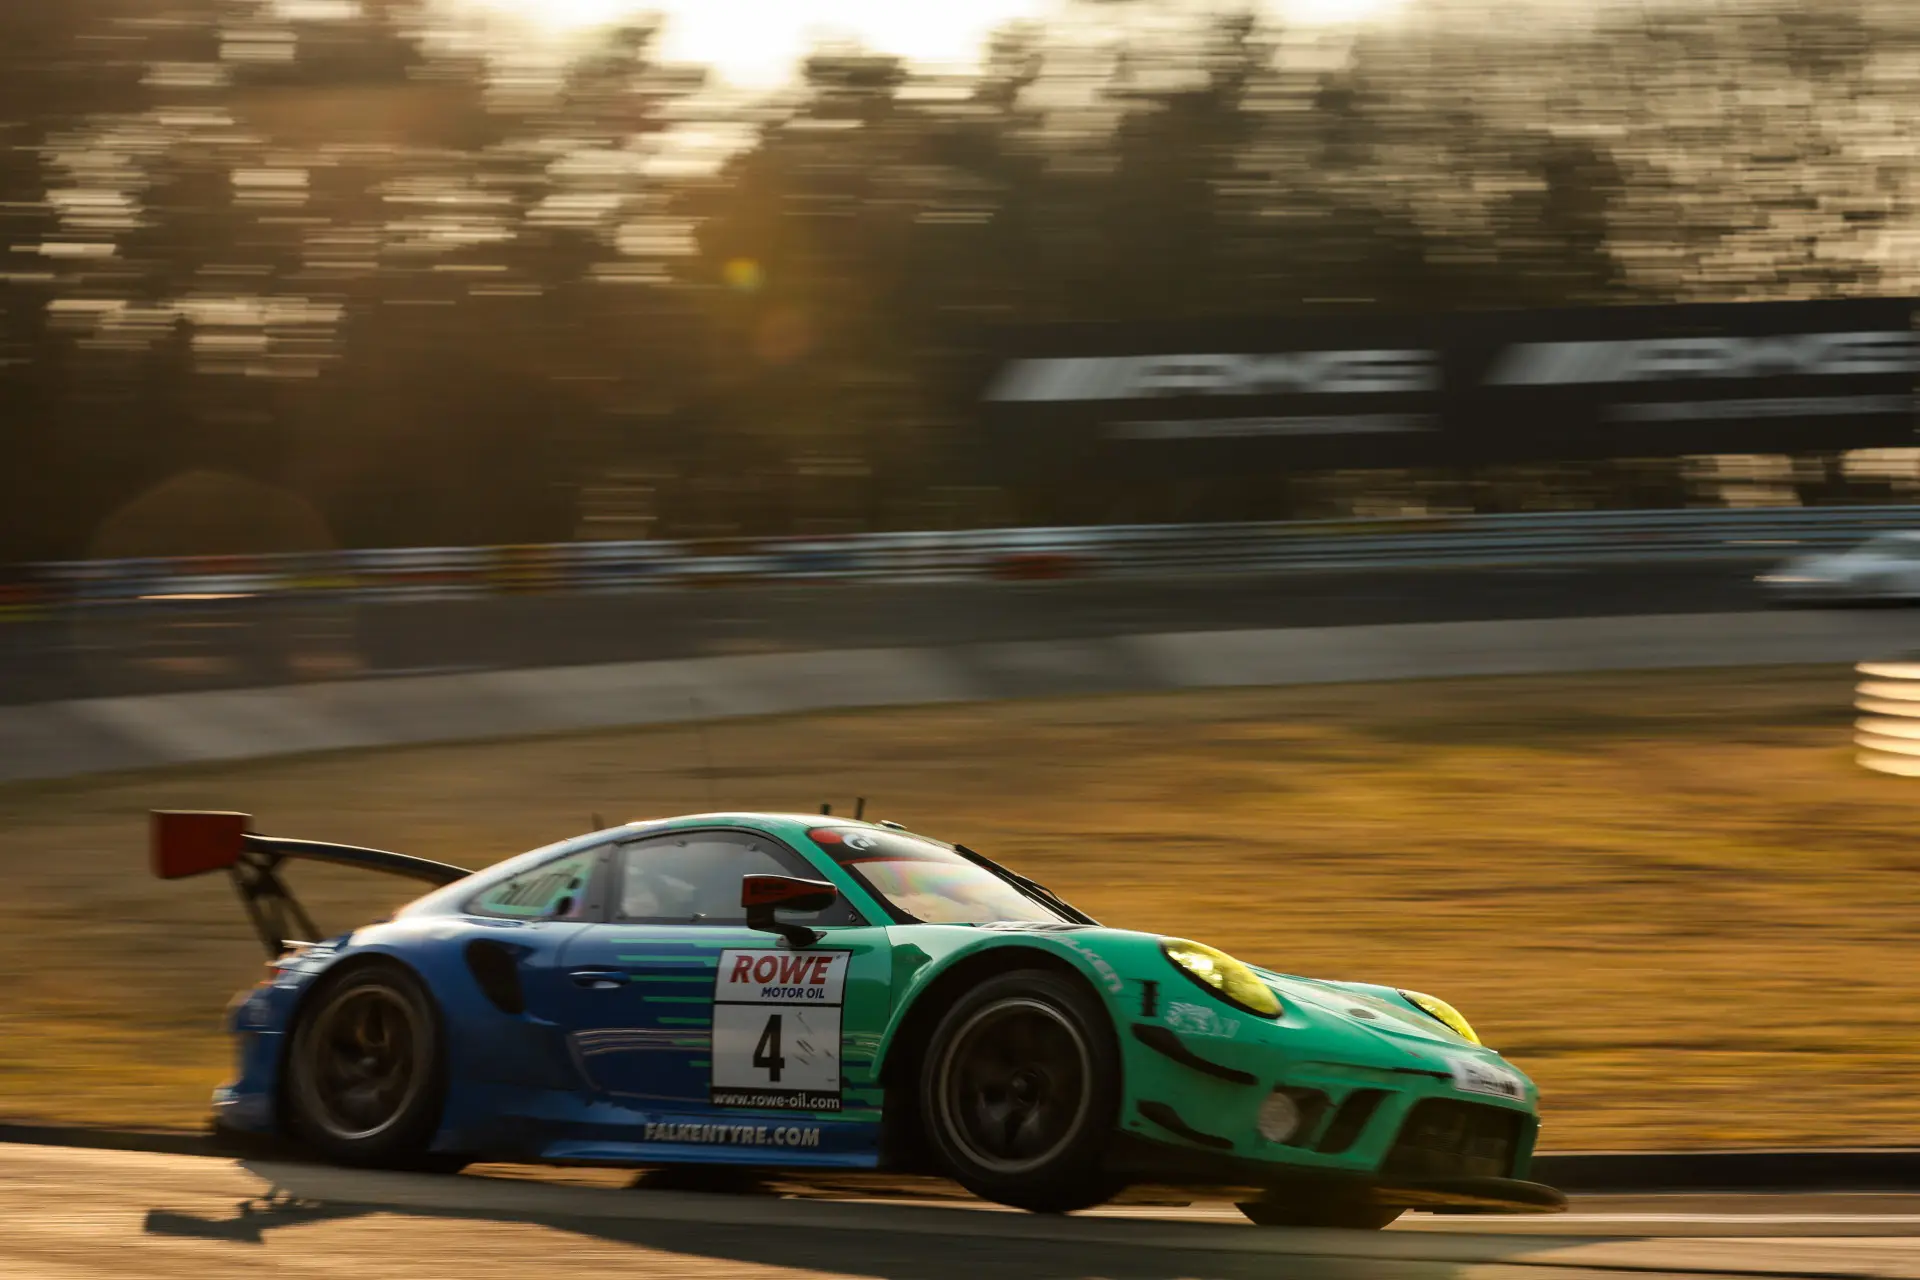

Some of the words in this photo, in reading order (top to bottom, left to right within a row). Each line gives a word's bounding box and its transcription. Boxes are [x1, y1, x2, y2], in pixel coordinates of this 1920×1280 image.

[729, 955, 833, 985] ROWE
[761, 986, 804, 999] MOTOR
[806, 987, 825, 999] OIL
[753, 1014, 785, 1082] 4
[713, 1093, 840, 1109] www.rowe-oil.com
[643, 1122, 820, 1147] FALKENTYRE.COM
